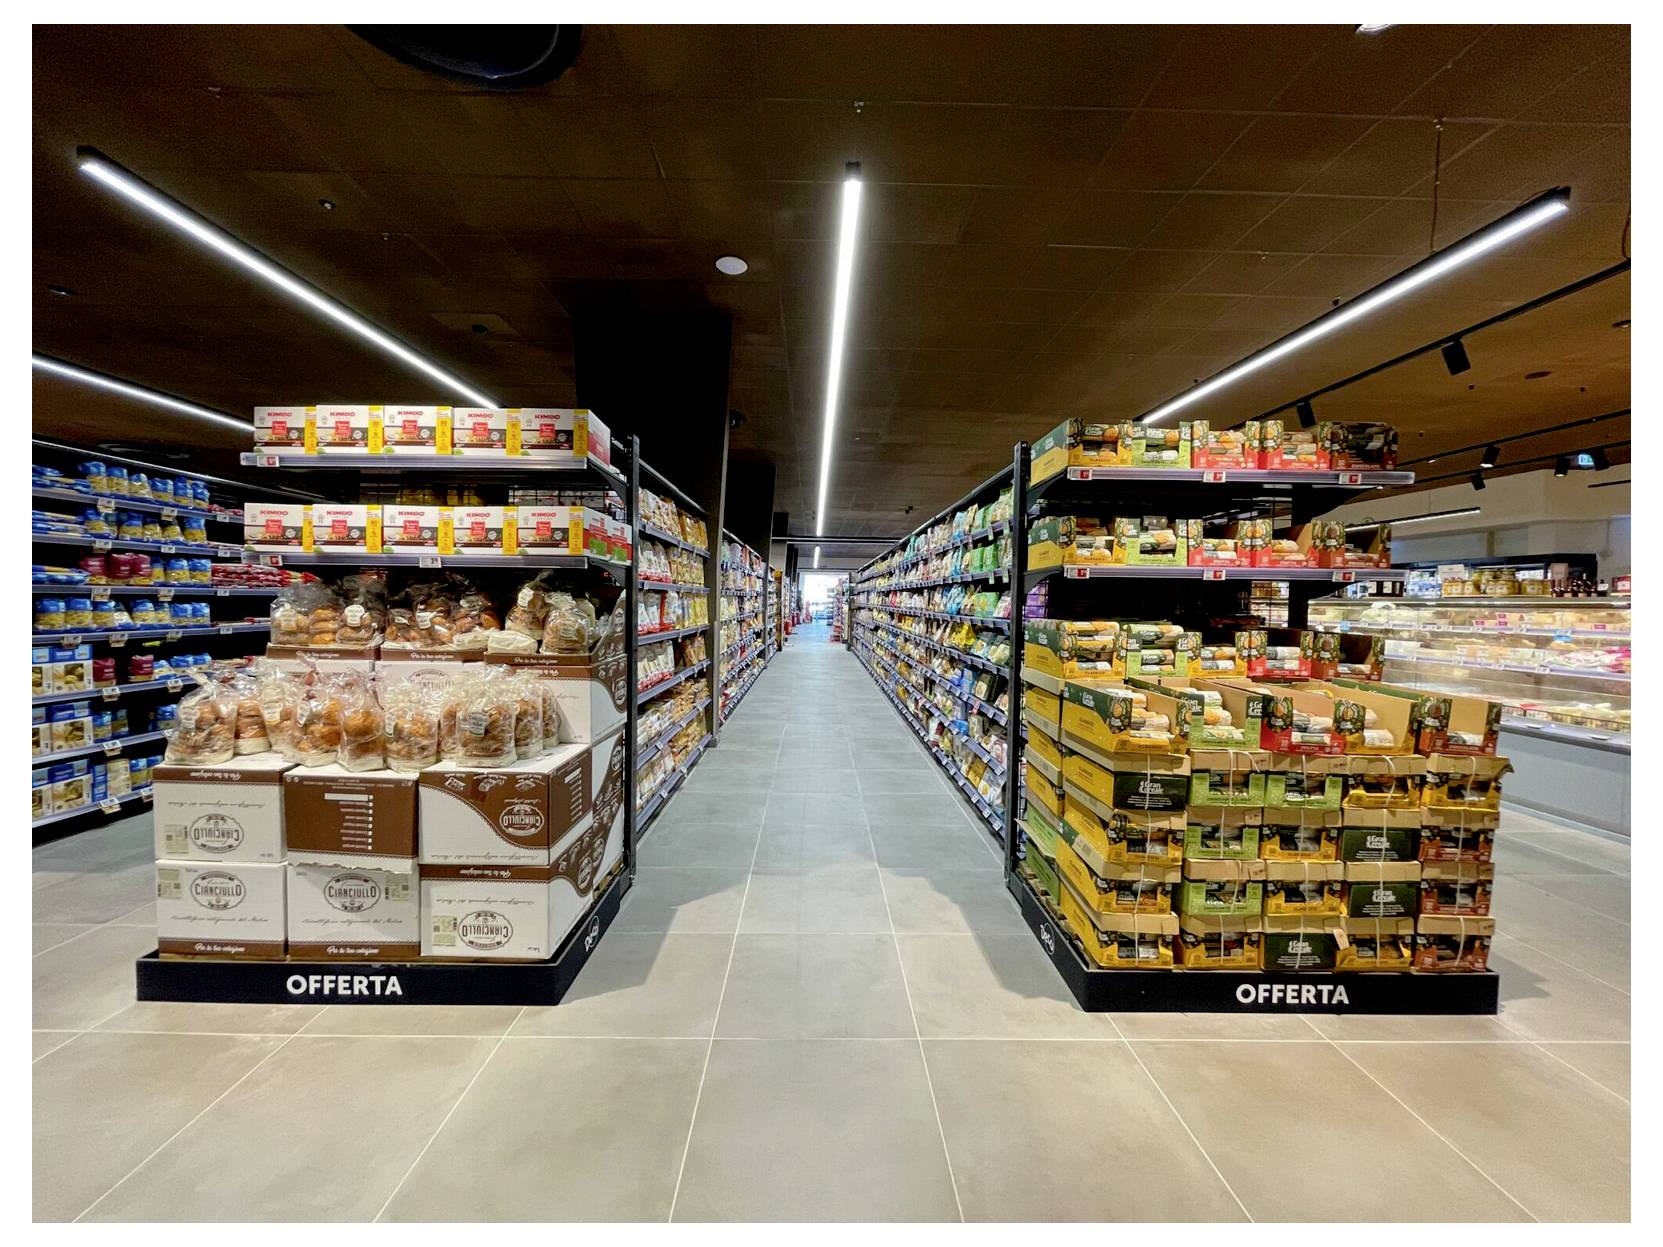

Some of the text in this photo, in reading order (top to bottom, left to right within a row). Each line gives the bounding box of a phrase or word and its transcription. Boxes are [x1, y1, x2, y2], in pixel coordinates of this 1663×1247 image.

[1143, 781, 1161, 789] Gran
[194, 827, 240, 841] CIANCIULLO
[195, 883, 242, 897] CIANCIULLO
[328, 886, 377, 898] CIANCIULLO
[462, 925, 509, 938] CIANCIULLO
[195, 943, 206, 951] Per
[221, 946, 245, 954] colazione
[327, 945, 339, 954] Per
[356, 947, 379, 955] colazione
[286, 974, 403, 996] OFFERTA
[1236, 983, 1350, 1005] OFFERTA
